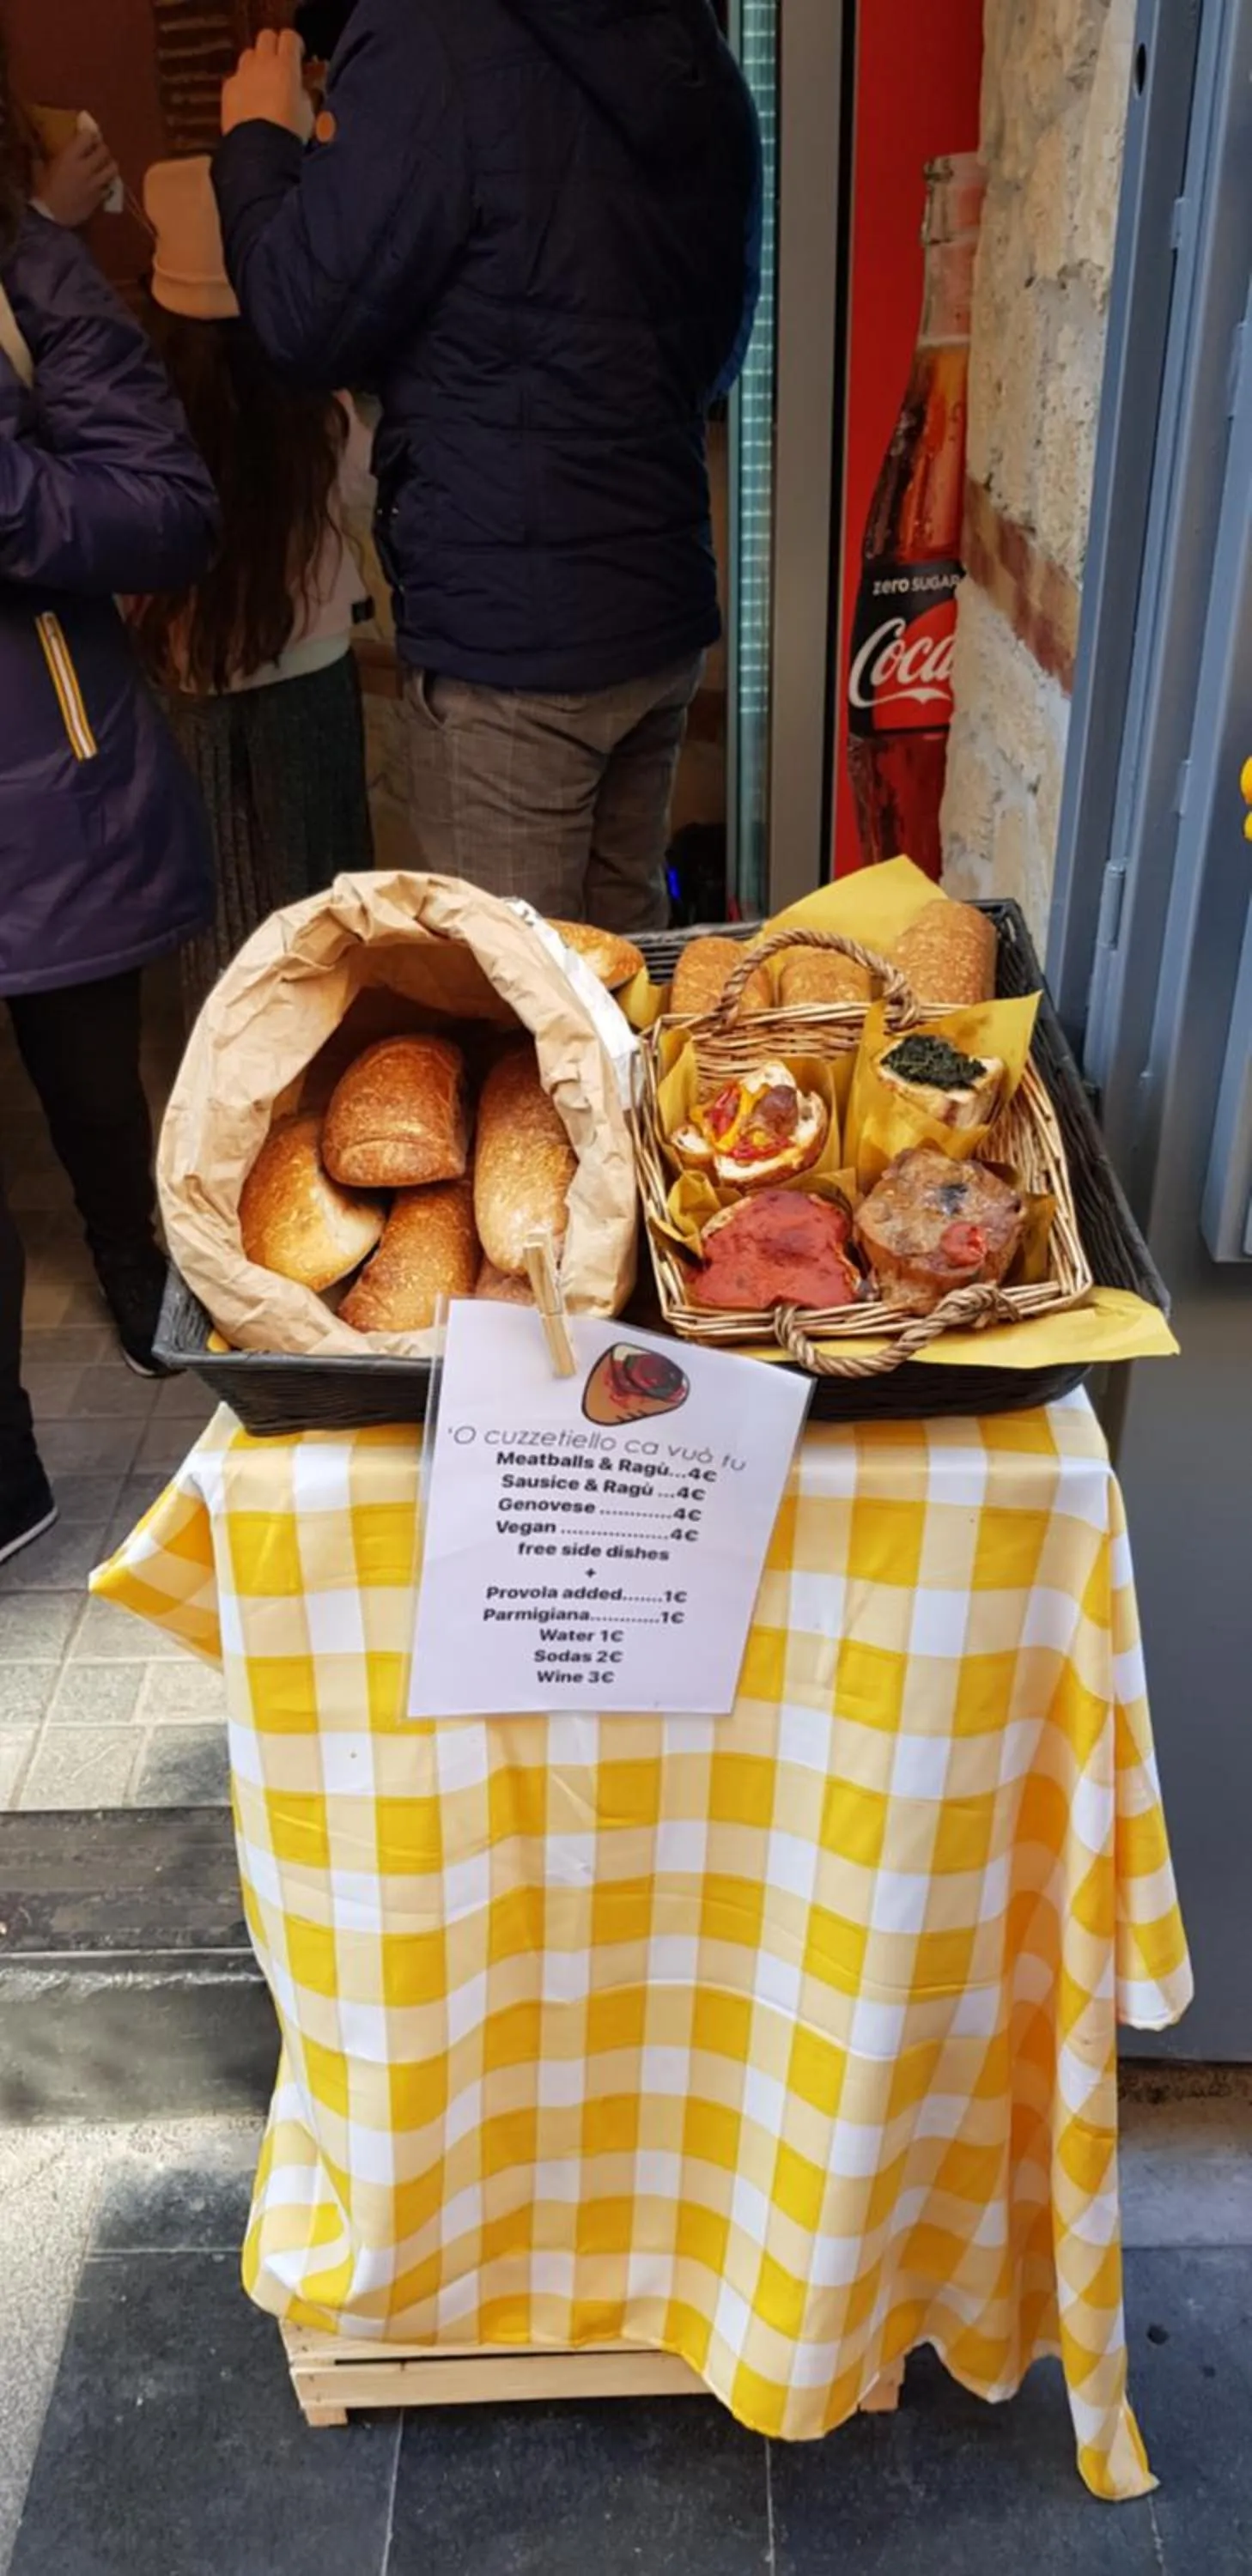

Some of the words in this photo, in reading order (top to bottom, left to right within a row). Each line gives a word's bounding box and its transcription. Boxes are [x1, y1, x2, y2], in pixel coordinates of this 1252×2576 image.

[872, 577, 910, 596] zero
[483, 1428, 617, 1451] cuzzetiello
[624, 1439, 659, 1455] ca
[722, 1453, 746, 1472] tu
[496, 1451, 594, 1469] Meatballs
[599, 1457, 612, 1471] &
[501, 1473, 580, 1491] Sausice
[584, 1478, 598, 1492] &
[603, 1479, 653, 1498] Ragù
[498, 1498, 596, 1514] Genovese
[496, 1520, 556, 1536] Vegan
[518, 1542, 556, 1555] free
[562, 1542, 601, 1558] side
[605, 1544, 670, 1561] dishes
[486, 1586, 557, 1601] Provola
[539, 1628, 594, 1642] Water
[600, 1630, 623, 1643] 1€
[533, 1649, 592, 1663] Sodas
[596, 1650, 623, 1663] 2€
[537, 1670, 583, 1683] Wine
[587, 1671, 615, 1683] 3€
